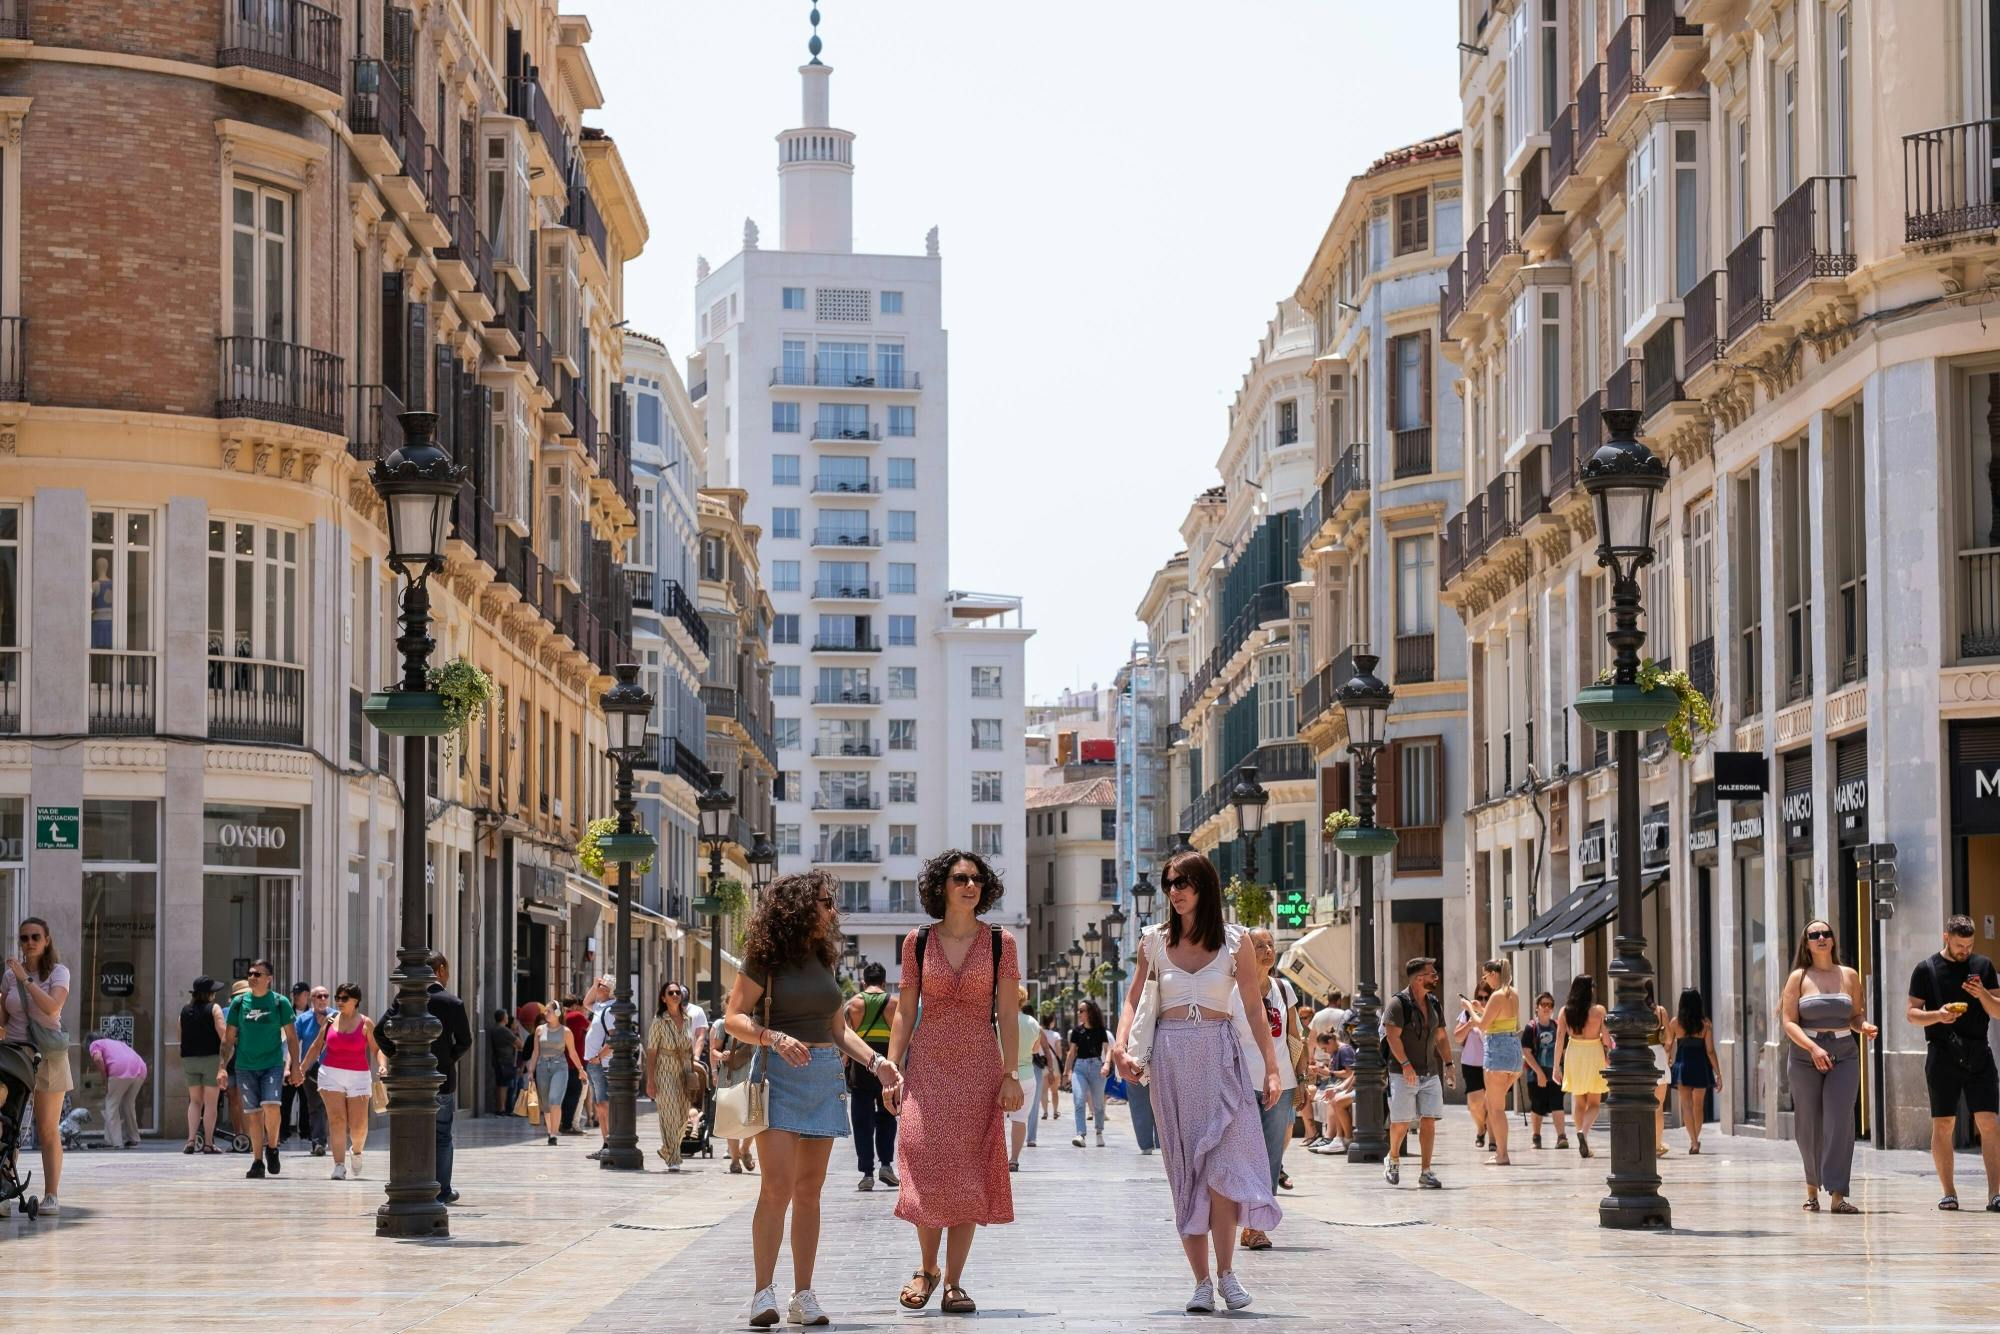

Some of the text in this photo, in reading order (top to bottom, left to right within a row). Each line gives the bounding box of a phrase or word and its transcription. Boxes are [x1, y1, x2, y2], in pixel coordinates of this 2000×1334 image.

[1782, 791, 1812, 823] MANGO
[1834, 780, 1866, 814] MANGO
[220, 824, 286, 849] OYSHO
